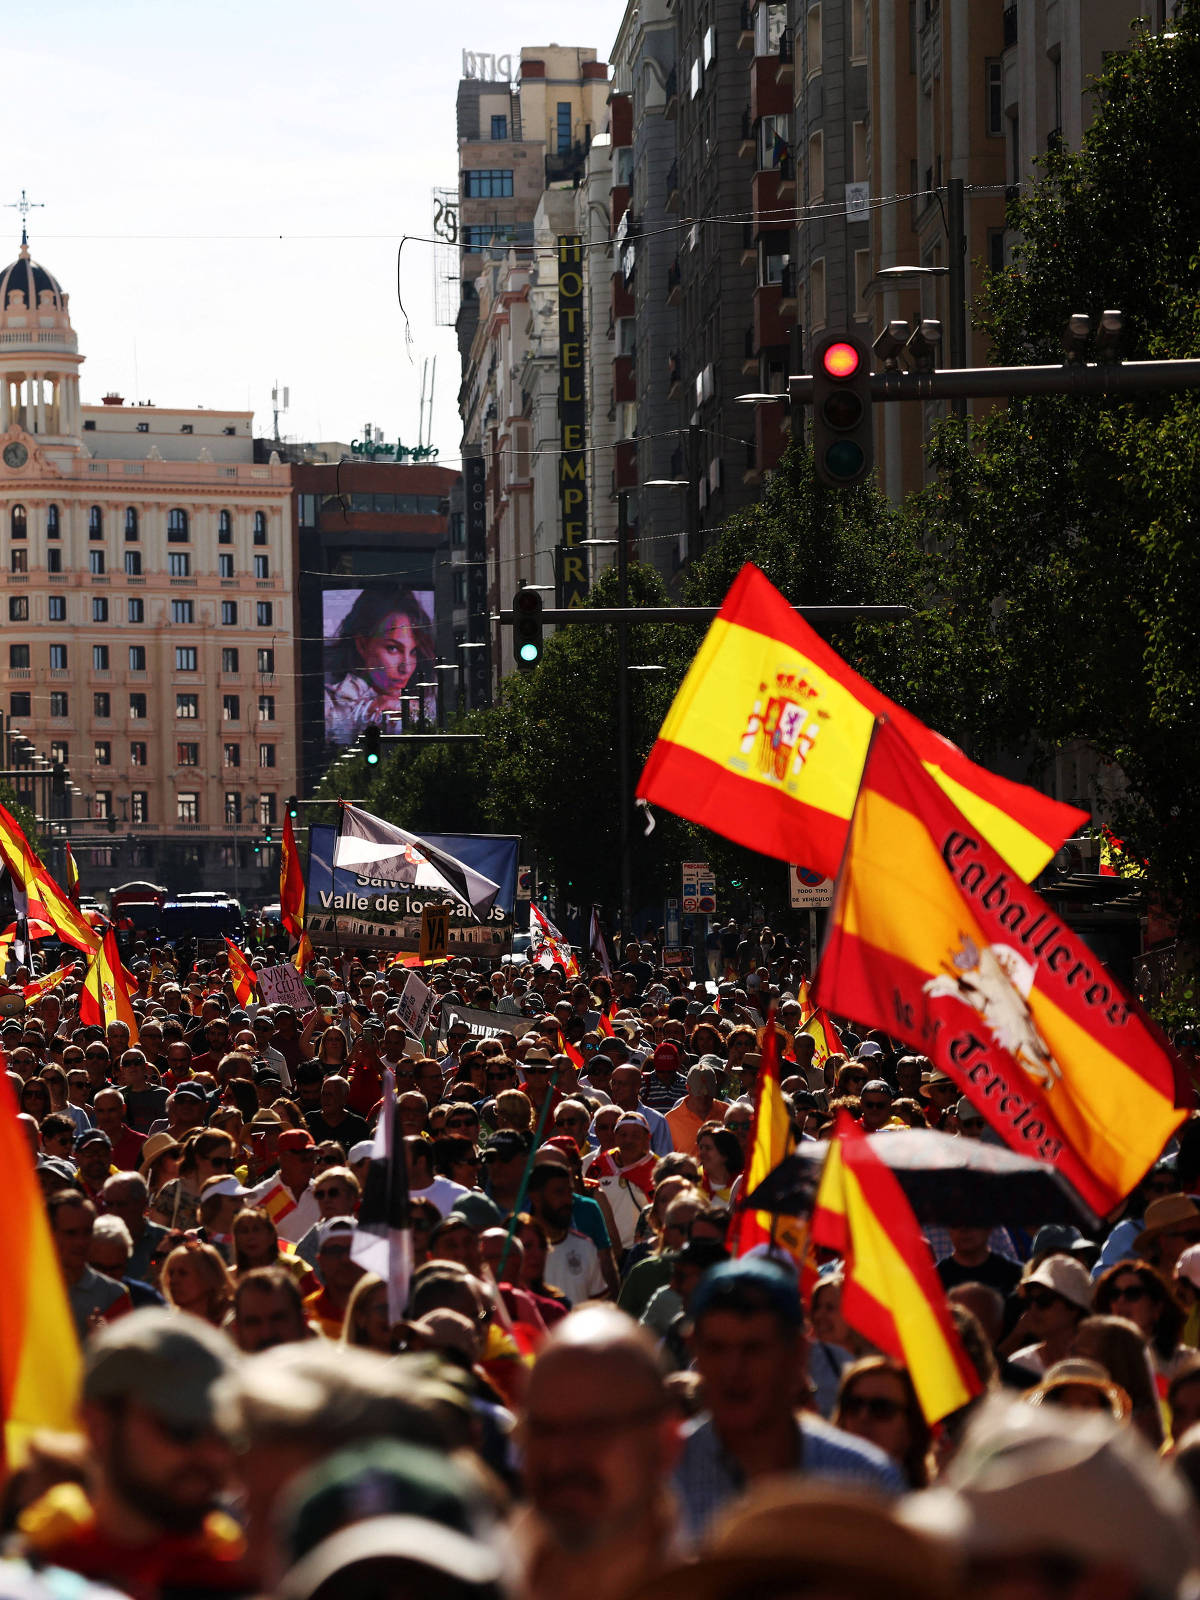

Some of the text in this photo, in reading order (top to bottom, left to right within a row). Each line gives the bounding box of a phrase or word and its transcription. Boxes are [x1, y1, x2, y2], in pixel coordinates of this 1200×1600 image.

[559, 238, 583, 402] HOTEL
[319, 890, 369, 910] Valle
[375, 895, 400, 912] de
[441, 898, 505, 921] Cas
[427, 918, 445, 951] YA
[943, 830, 1134, 1026] Caballeros
[264, 968, 292, 983] VIVA
[449, 1012, 505, 1039] CRUPT
[949, 1032, 1063, 1160] Tercios
